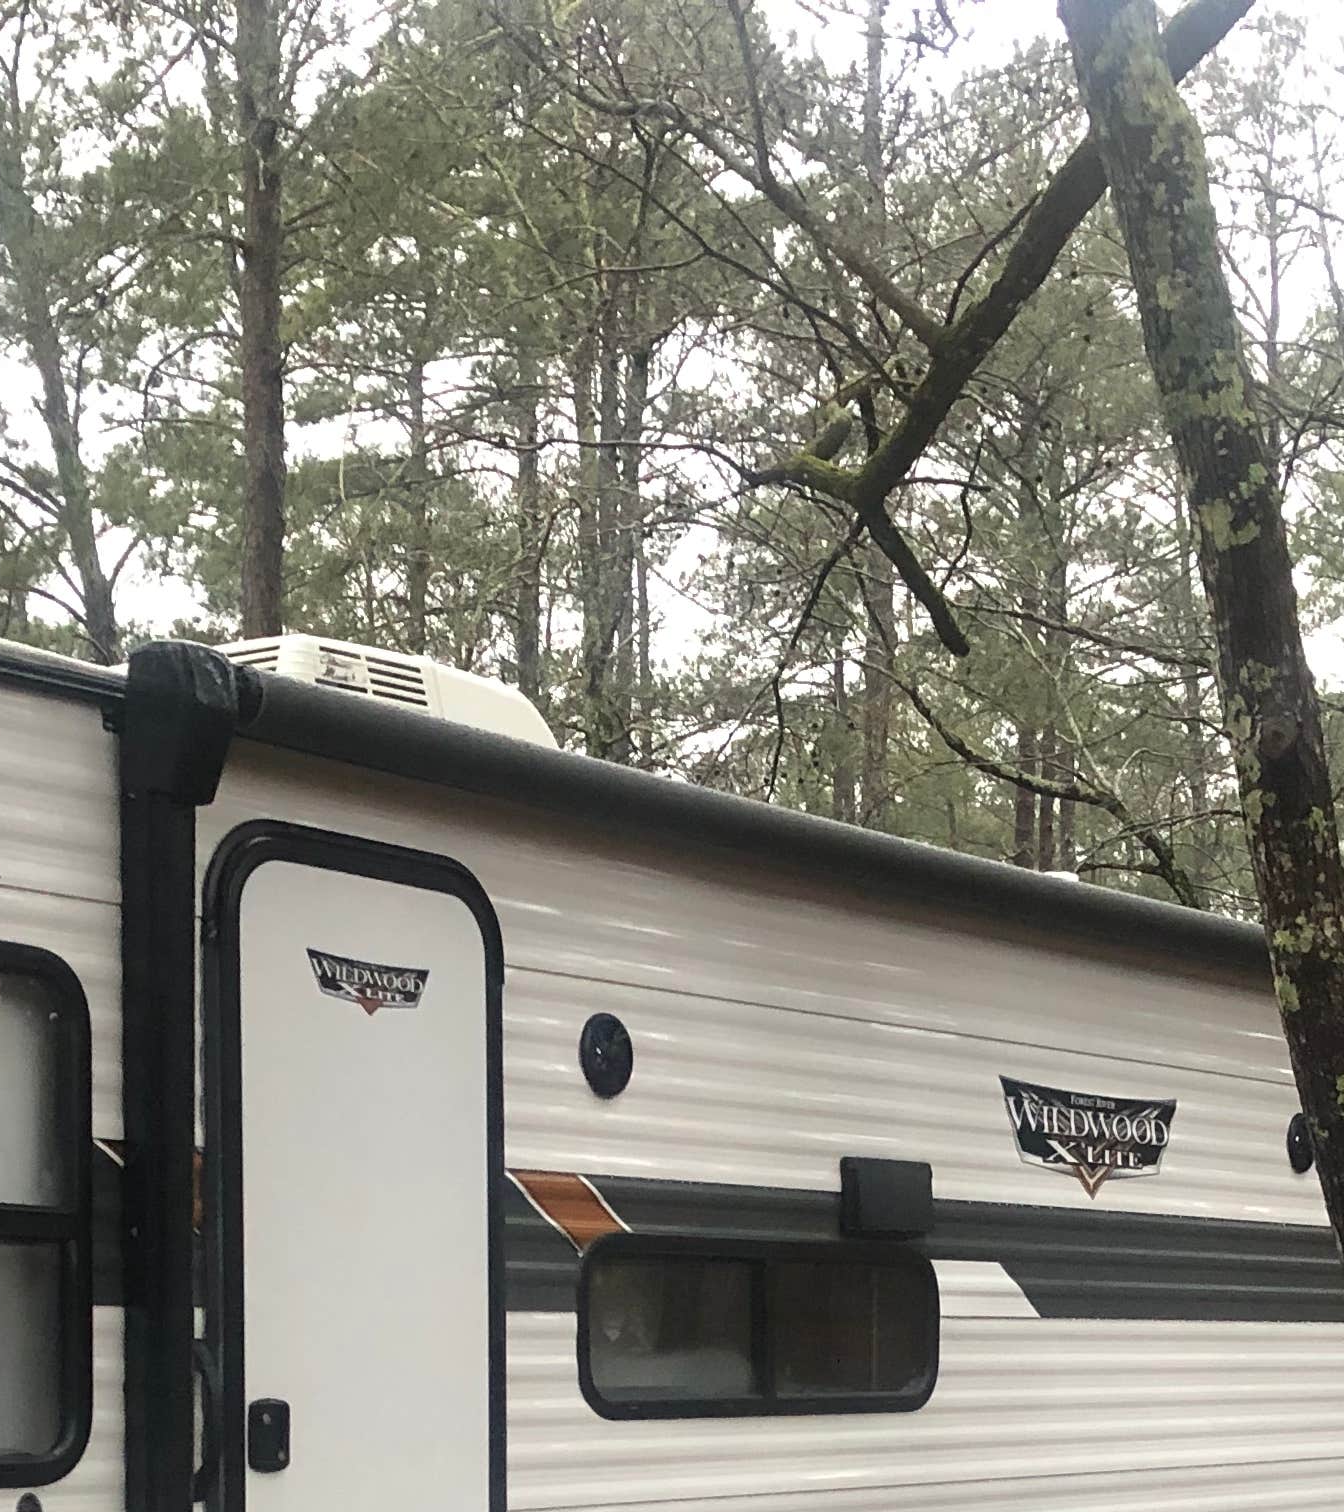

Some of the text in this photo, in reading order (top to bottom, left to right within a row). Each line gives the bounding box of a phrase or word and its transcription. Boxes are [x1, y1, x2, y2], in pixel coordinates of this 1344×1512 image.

[312, 957, 423, 993] WILDWOOD
[366, 988, 405, 1002] LITE
[1006, 1096, 1168, 1146] WILDWOOD
[1087, 1146, 1144, 1169] LITE
